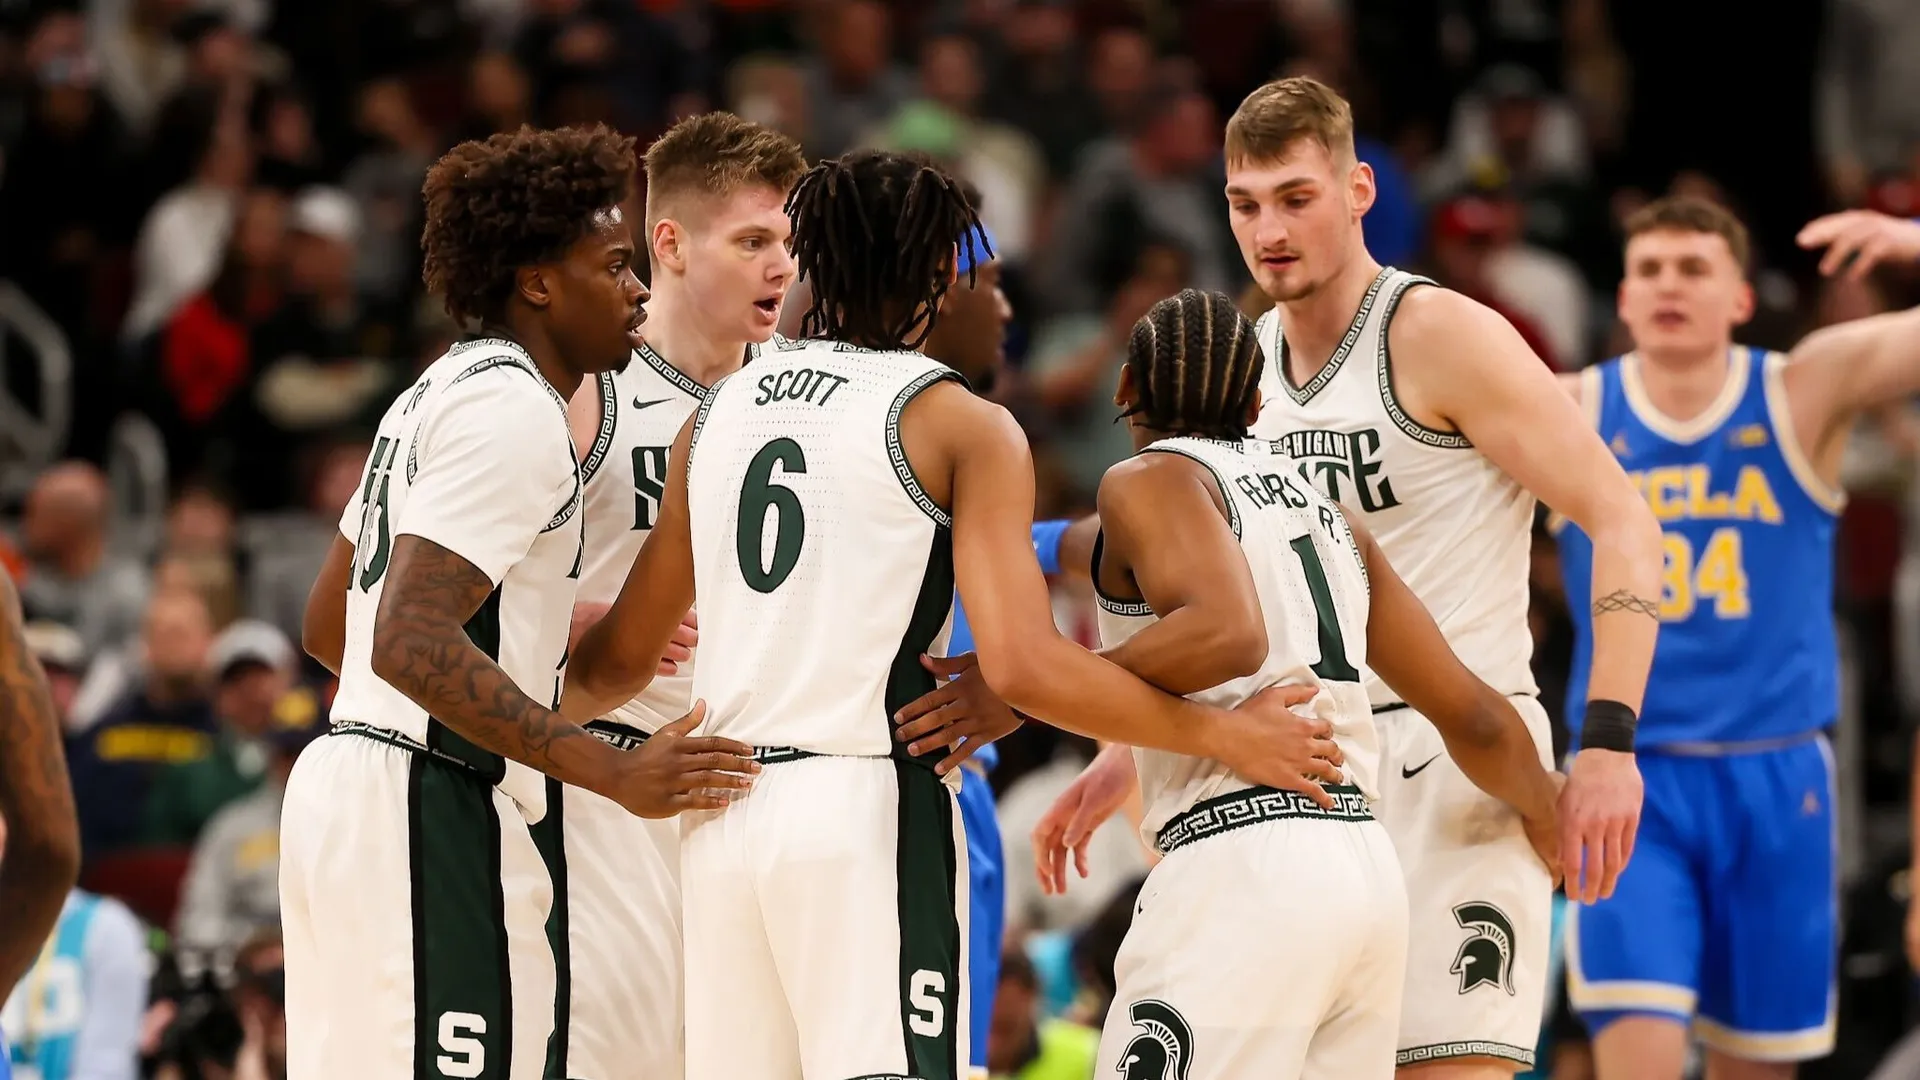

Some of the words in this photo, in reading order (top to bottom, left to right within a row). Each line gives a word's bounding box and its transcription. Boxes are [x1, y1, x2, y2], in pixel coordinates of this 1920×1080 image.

[755, 368, 849, 407] SCOTT
[1282, 430, 1349, 459] CHIGAN
[736, 437, 807, 594] 6
[1318, 505, 1341, 544] R.
[1628, 463, 1785, 526] CLA
[1289, 533, 1361, 683] 1
[908, 968, 946, 1038] S
[436, 1010, 487, 1079] S
